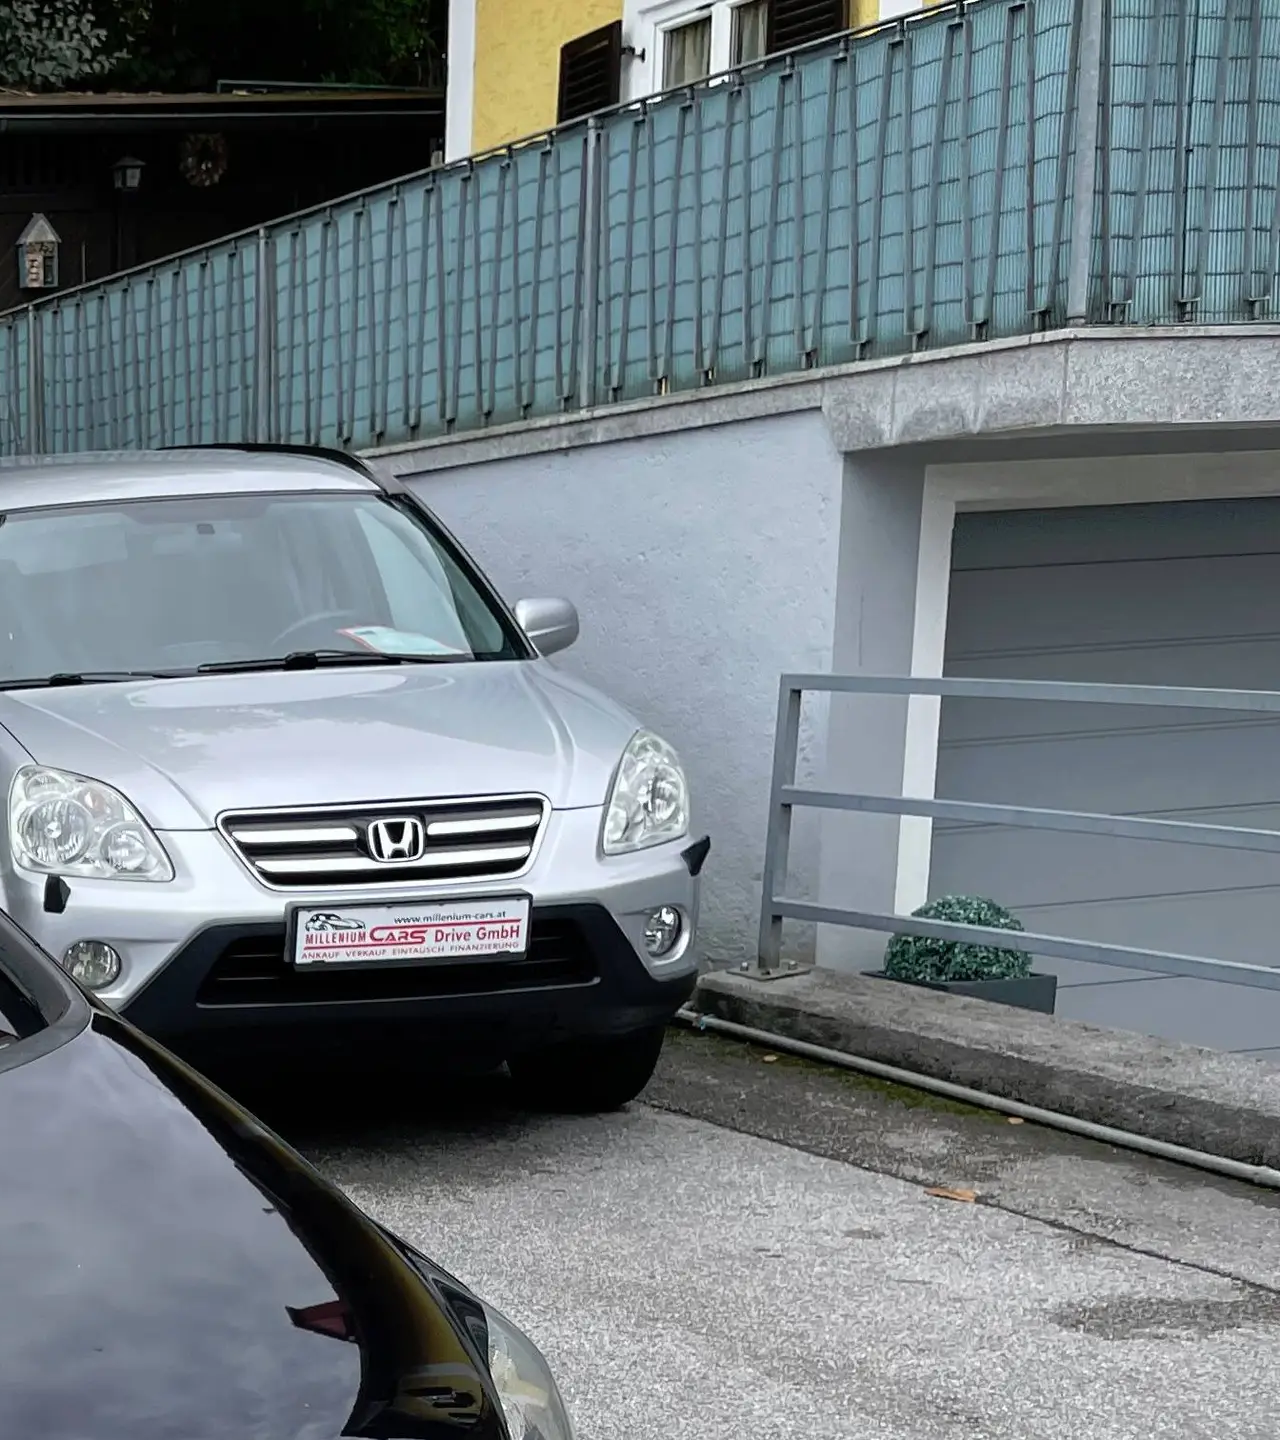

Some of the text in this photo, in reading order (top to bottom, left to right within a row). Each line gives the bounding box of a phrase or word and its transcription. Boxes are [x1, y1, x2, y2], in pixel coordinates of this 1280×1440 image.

[394, 911, 506, 924] www.millenium-cars.at
[305, 924, 520, 945] MILLENIUM CARS Drive GmbH
[301, 941, 519, 960] ANKAUF VERKAUF EINTAUSCH FINANZIERUNG
